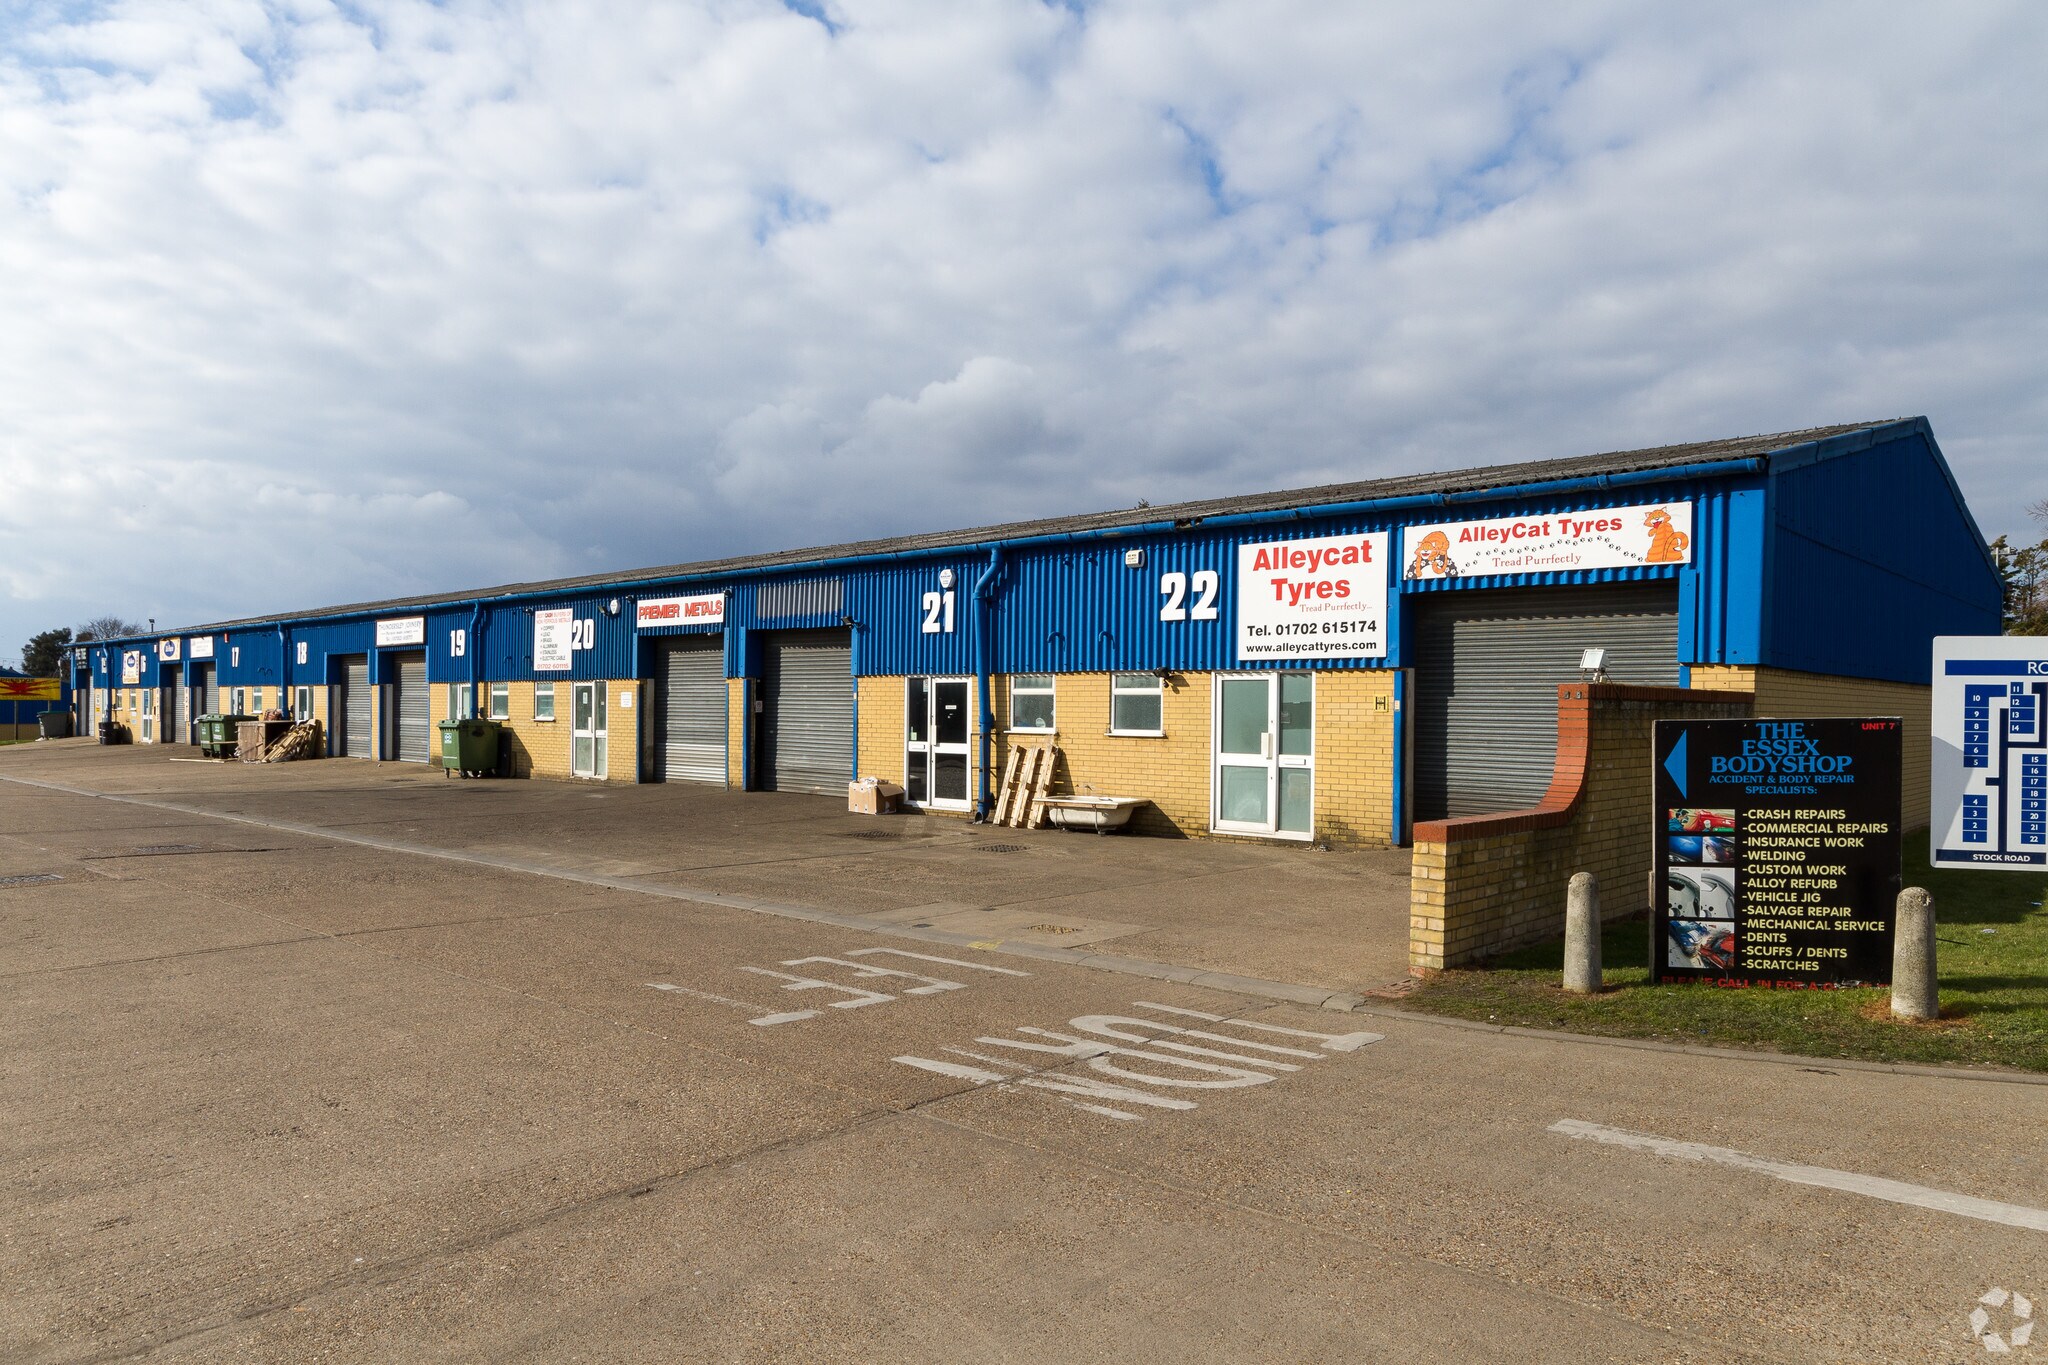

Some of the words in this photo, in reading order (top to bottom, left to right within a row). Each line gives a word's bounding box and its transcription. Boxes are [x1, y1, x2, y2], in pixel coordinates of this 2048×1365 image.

[1459, 523, 1550, 543] AlleyCat
[1560, 517, 1622, 539] Tyres
[1253, 540, 1372, 573] Alleycat
[1492, 556, 1521, 567] Tread
[1525, 553, 1581, 567] Purrfectly
[1160, 570, 1218, 621] 22
[1271, 577, 1350, 607] Tyres
[638, 604, 680, 620] PREMIER
[685, 599, 722, 617] METALS
[922, 591, 955, 633] 21
[1300, 604, 1322, 613] Tread
[572, 619, 594, 649] 20
[1248, 624, 1271, 637] Tel.
[1276, 621, 1317, 635] 01702
[1322, 620, 1377, 634] 615174
[450, 629, 466, 657] 19
[1246, 640, 1377, 653] www.alleycattyres.com
[231, 646, 240, 668] 17
[297, 641, 308, 665] 18
[1756, 723, 1805, 739] THE
[1742, 739, 1819, 756] ESSEX
[1711, 756, 1852, 773] BODYSHOP
[1709, 775, 1764, 783] ACCIDENT
[1767, 775, 1775, 783] &
[1779, 775, 1809, 783] BODY
[1815, 775, 1854, 783] REPAIR
[1745, 786, 1817, 794] SPECIALISTS:
[1742, 810, 1791, 819] -CRASH
[1795, 810, 1845, 819] REPAIRS
[1742, 824, 1833, 833] -COMMERCIAL
[1837, 824, 1888, 833] REPAIRS
[1742, 837, 1820, 847] -INSURANCE
[1824, 838, 1864, 847] WORK
[1741, 851, 1805, 861] -WELDING
[2005, 854, 2030, 862] ROAD
[1741, 865, 1803, 875] -CUSTOM
[1807, 865, 1846, 875] WORK
[1741, 879, 1786, 888] -ALLOY
[1790, 879, 1837, 889] REFURB
[1741, 892, 1797, 902] -VEHICLE
[1801, 893, 1821, 902] JIG
[1741, 906, 1803, 916] -SALVAGE
[1807, 907, 1851, 916] REPAIR
[1741, 919, 1831, 930] -MECHANICAL
[1834, 921, 1885, 931] SERVICE
[1741, 933, 1787, 942] -DENTS
[1741, 947, 1792, 956] -SCUFFS
[1797, 947, 1802, 956] /
[1807, 948, 1847, 958] DENTS
[1741, 960, 1819, 970] -SCRATCHES
[645, 947, 1033, 1026] LEFT
[1718, 978, 1749, 988] CALL
[890, 1002, 1386, 1121] TURN
